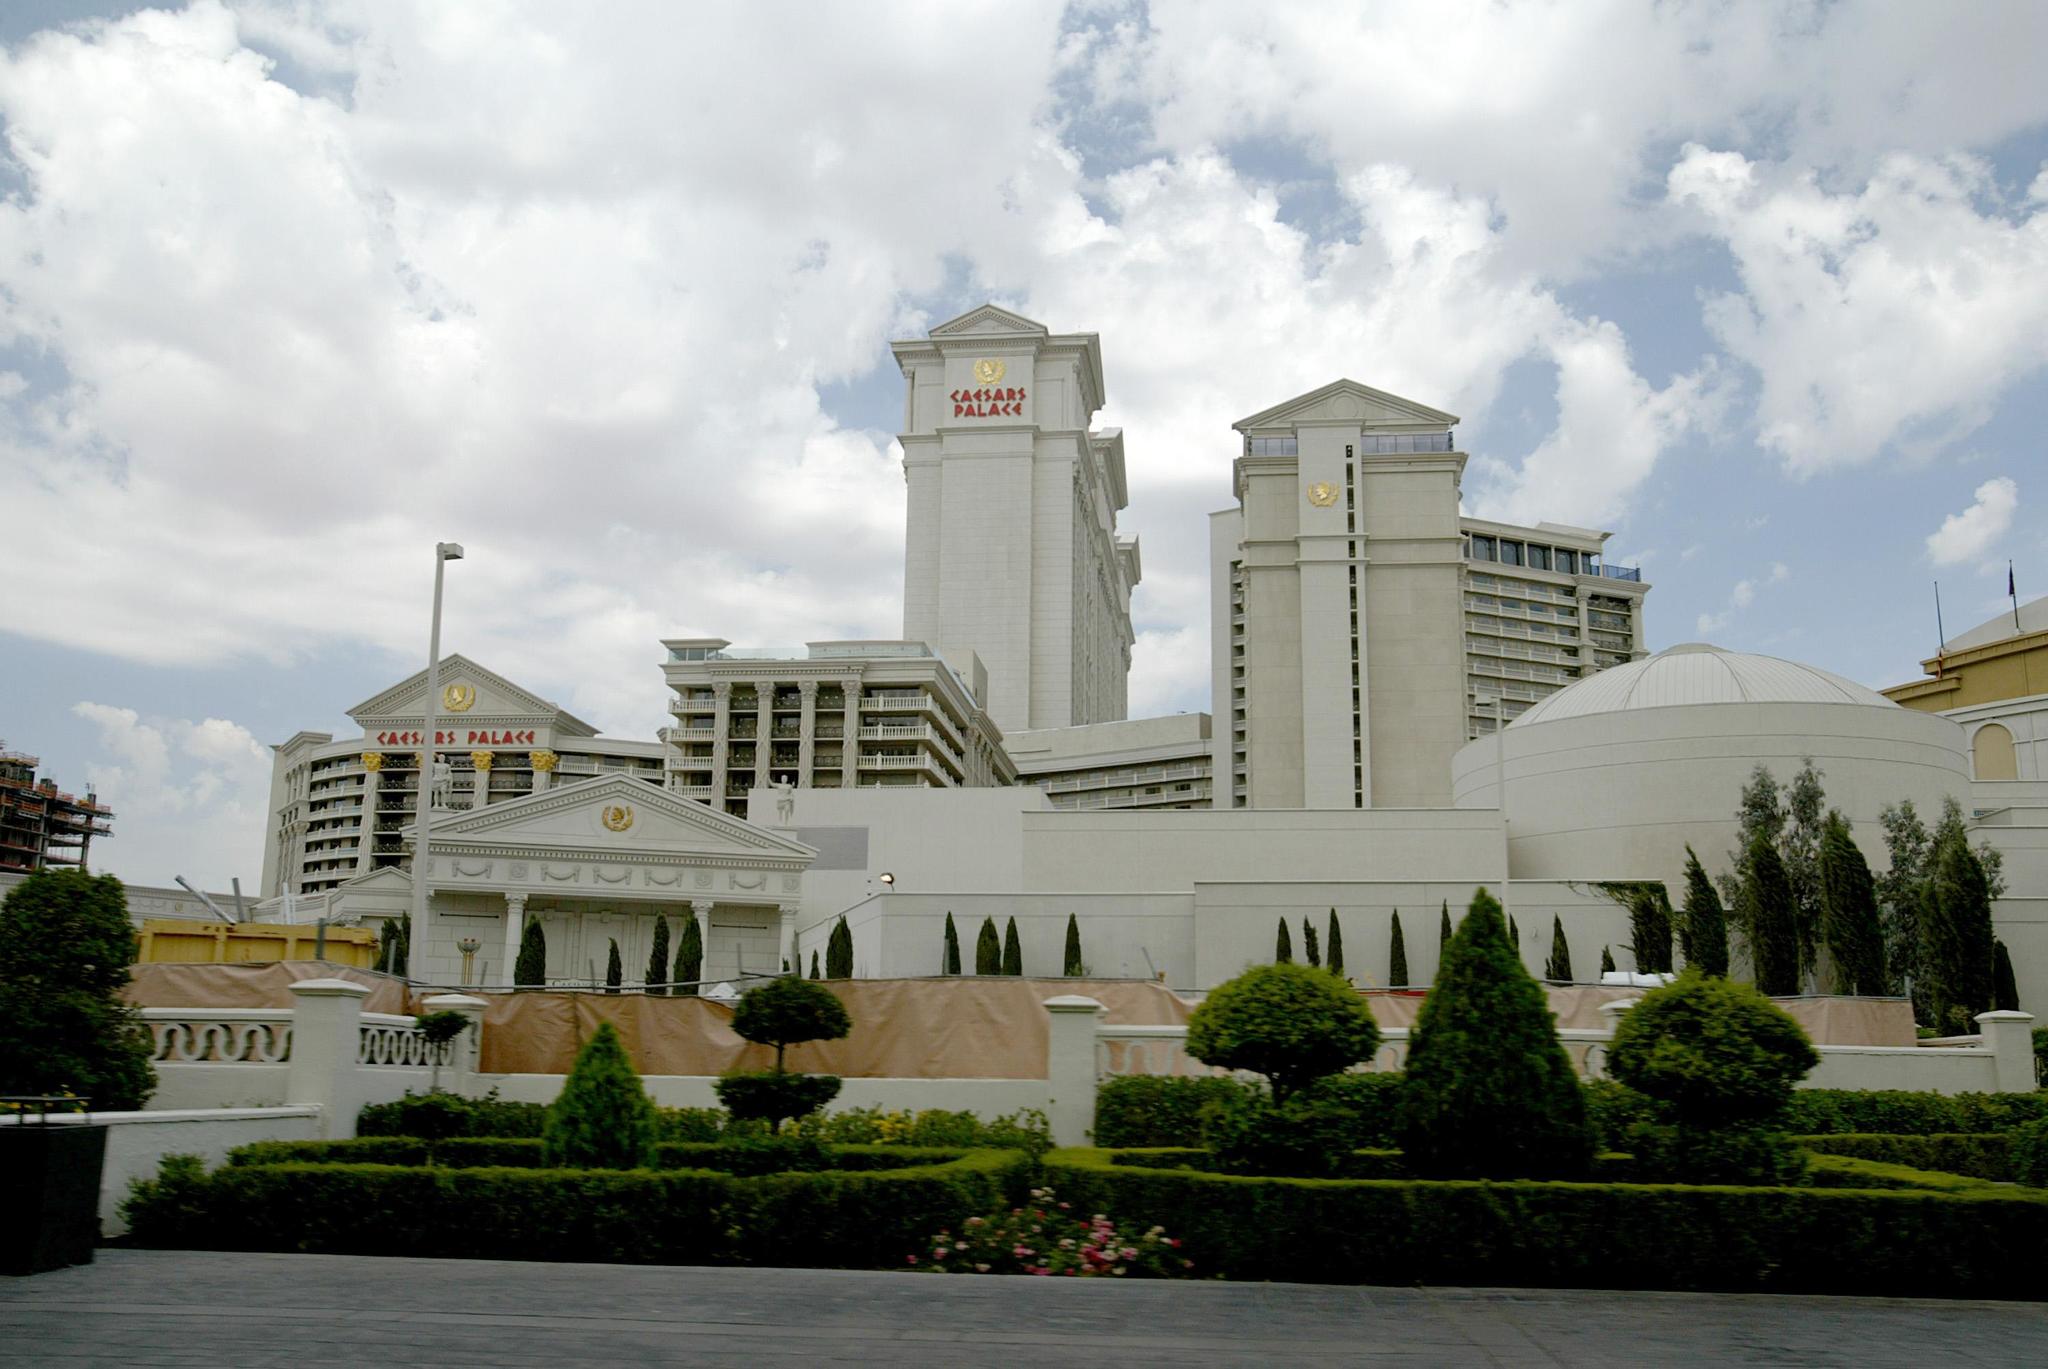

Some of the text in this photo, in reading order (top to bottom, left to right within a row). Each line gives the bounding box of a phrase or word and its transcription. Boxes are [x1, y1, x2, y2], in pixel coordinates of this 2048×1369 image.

[950, 387, 1026, 402] CAESARS
[954, 402, 1022, 418] PALACE
[468, 730, 536, 745] PALACE
